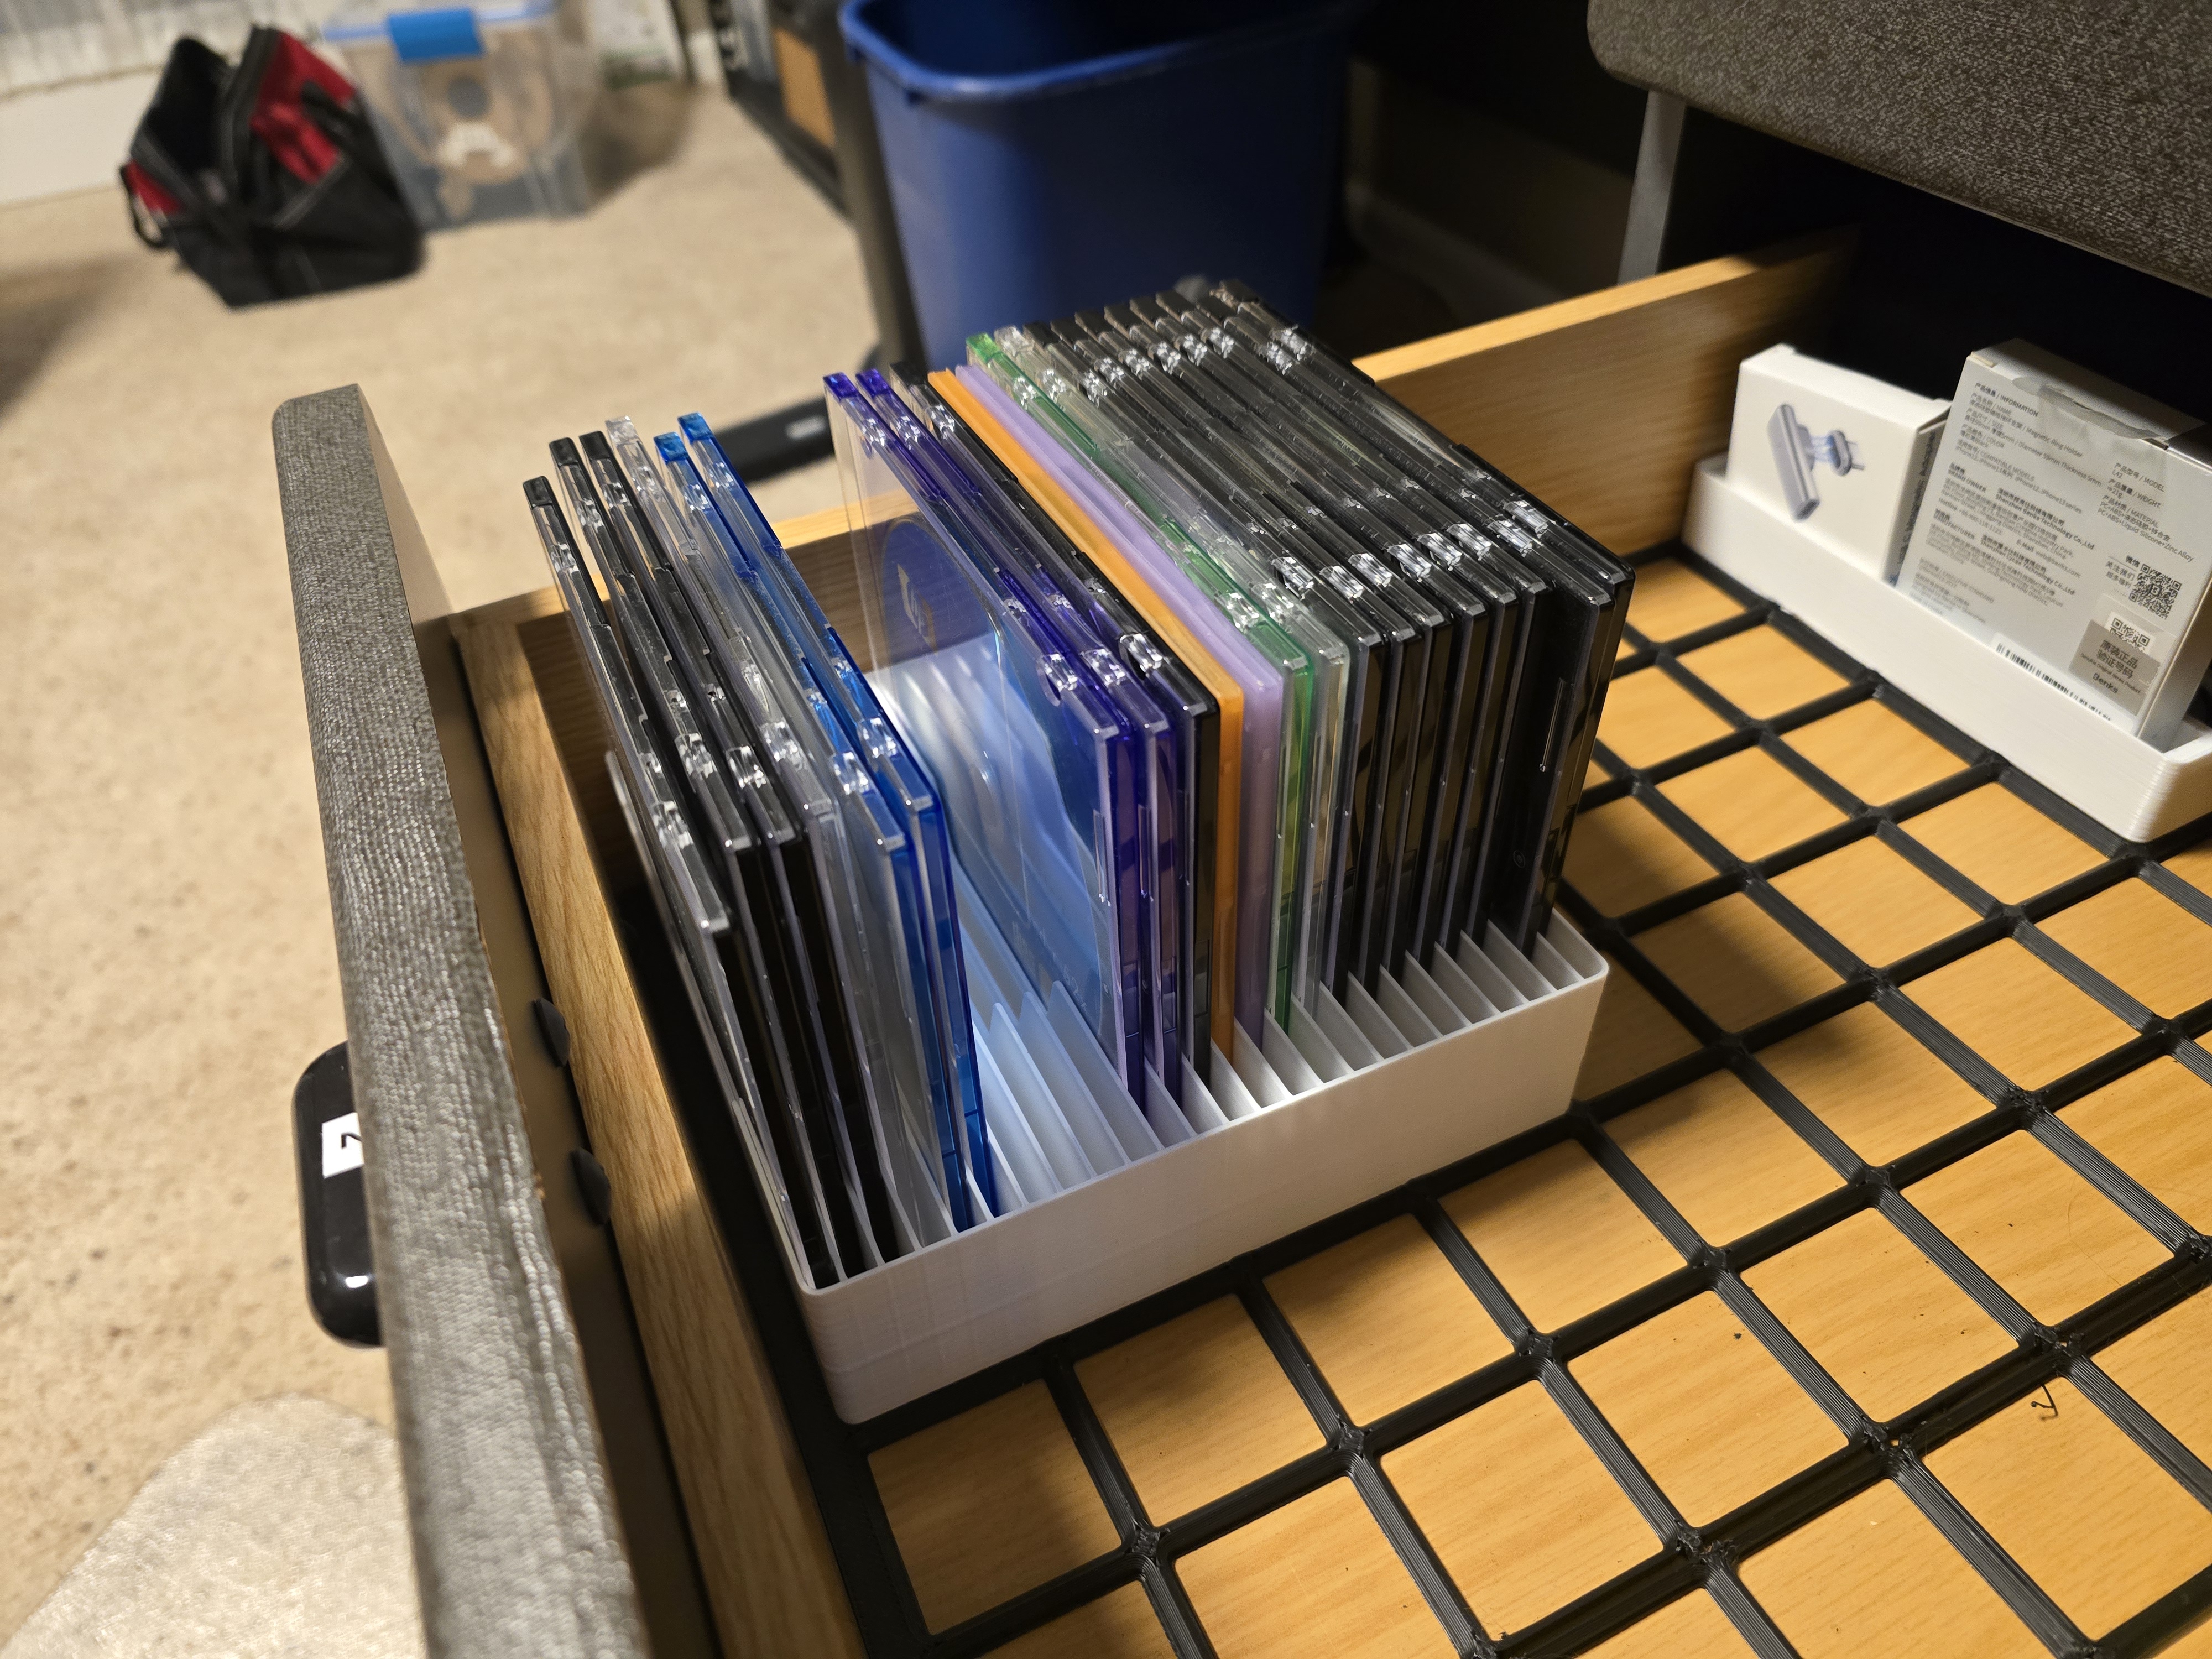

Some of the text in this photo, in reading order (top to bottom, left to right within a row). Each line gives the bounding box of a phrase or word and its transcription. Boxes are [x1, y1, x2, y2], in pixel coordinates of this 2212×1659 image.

[2000, 395, 2038, 417] INFORMATION
[2026, 427, 2049, 444] Magnetic
[2051, 439, 2063, 450] Ring
[2064, 445, 2083, 458] Holder
[2060, 461, 2086, 478] Thickness
[2087, 474, 2101, 486] 5mm
[2115, 462, 2139, 479] 产品型号
[2143, 477, 2165, 492] MODEL
[2137, 493, 2161, 509] WEIGHT
[1995, 494, 2022, 512] Shenzhen
[2041, 518, 2073, 539] Technology
[2130, 509, 2159, 528] MATERIAL
[2097, 508, 2194, 563] PC+ABS+Liquid Silicone+Zinc Alloy
[2105, 560, 2135, 581] 关注我们
[2096, 649, 2132, 680] 验证号码
[2100, 639, 2137, 669] 原装正品
[2093, 672, 2118, 694] Benks
